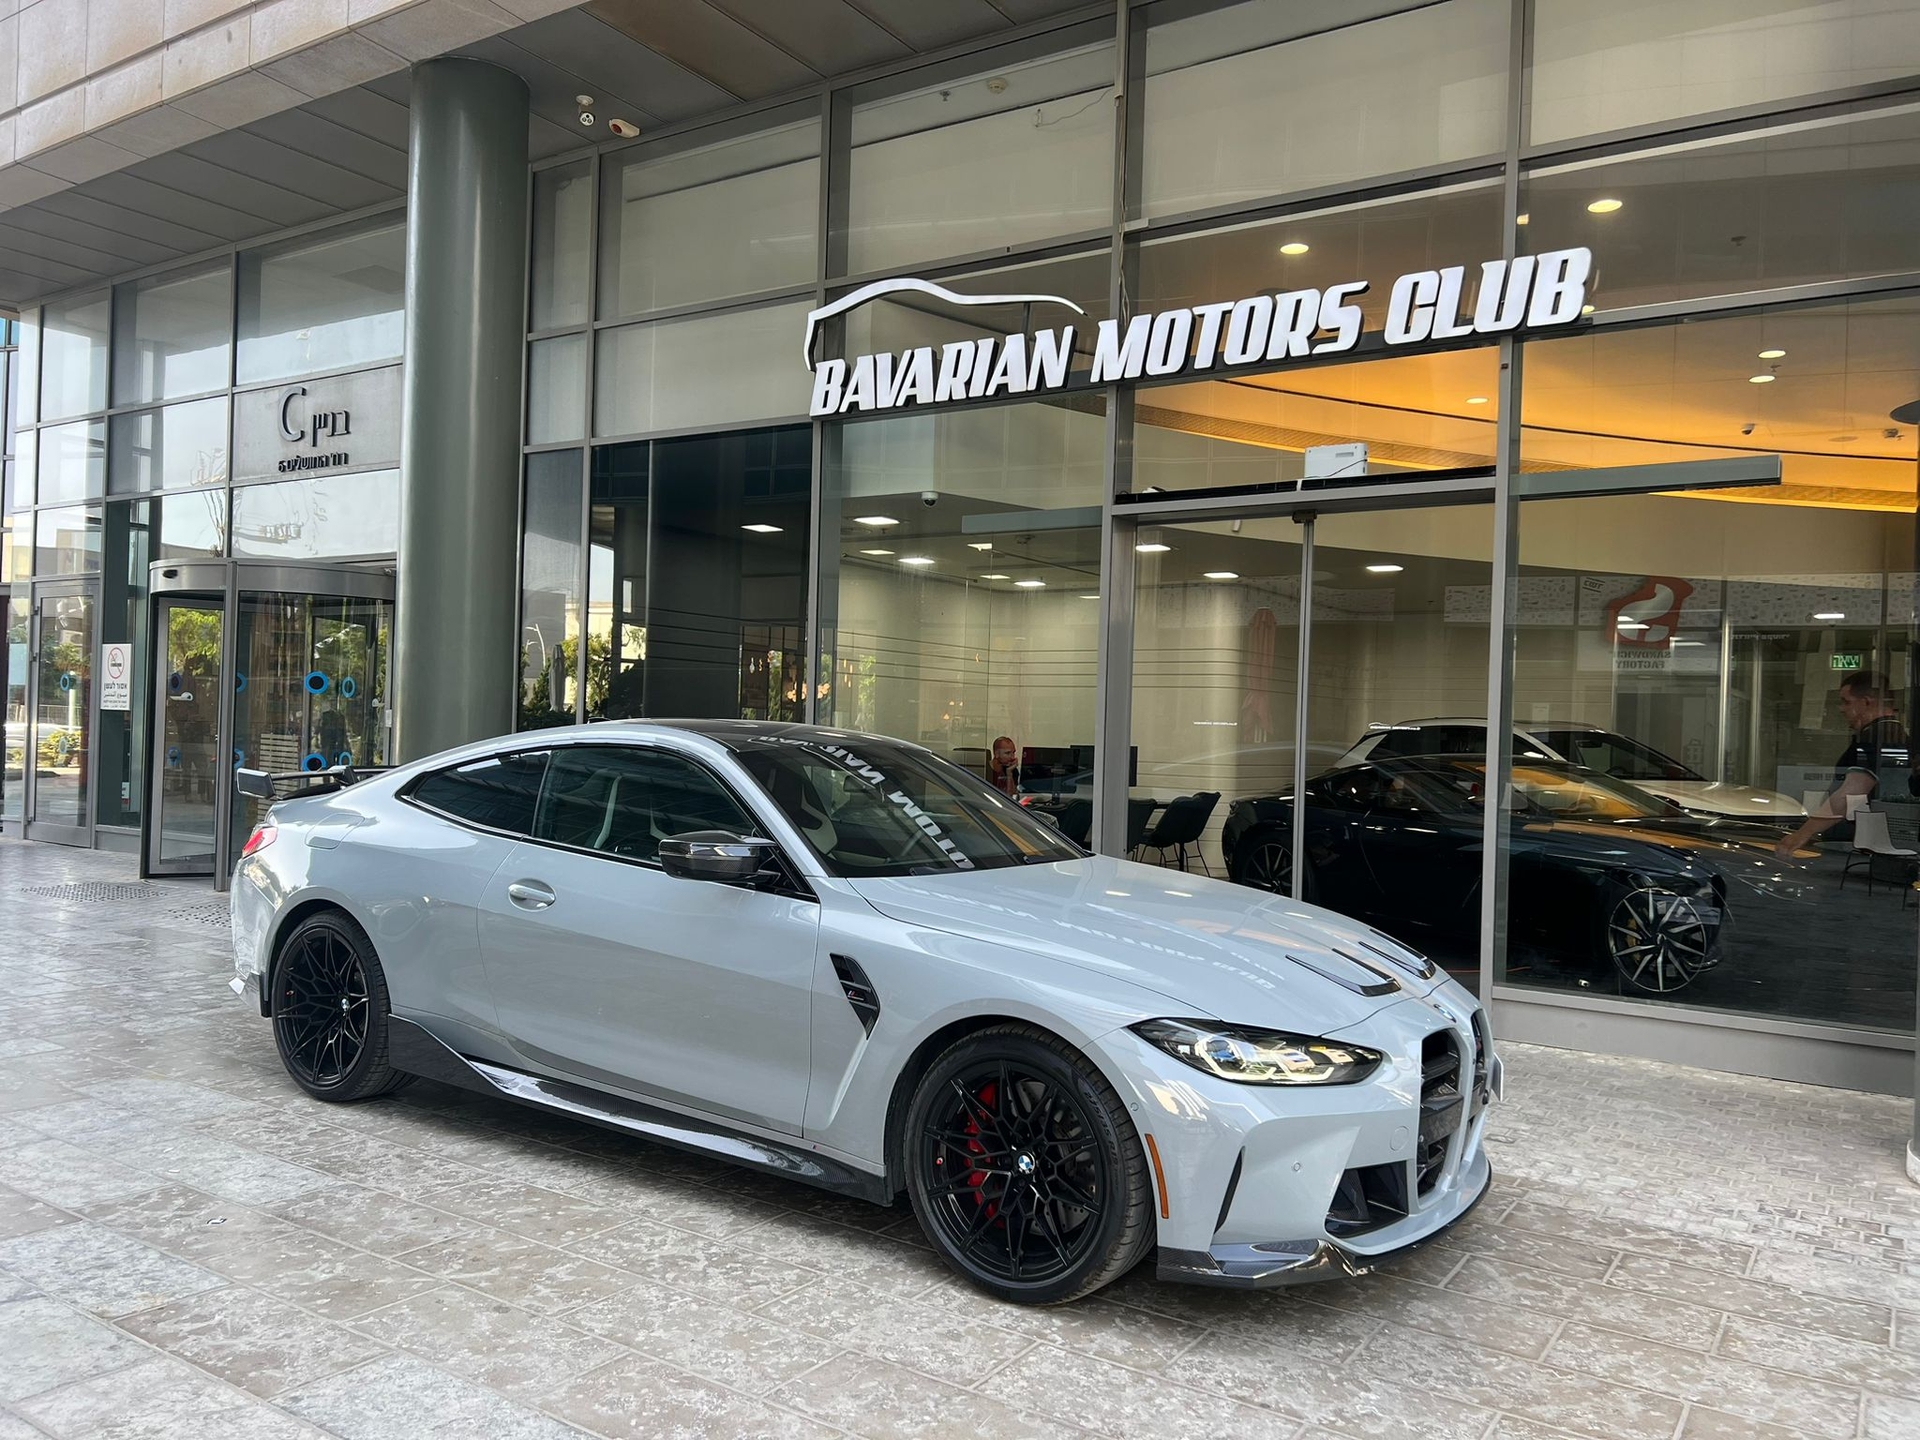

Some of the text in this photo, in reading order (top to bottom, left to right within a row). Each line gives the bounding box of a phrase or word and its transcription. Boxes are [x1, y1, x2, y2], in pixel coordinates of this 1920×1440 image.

[809, 247, 1592, 417] BAVARIAN MOTORS CLUB
[278, 386, 307, 442] C
[1832, 655, 1859, 668] יציאה
